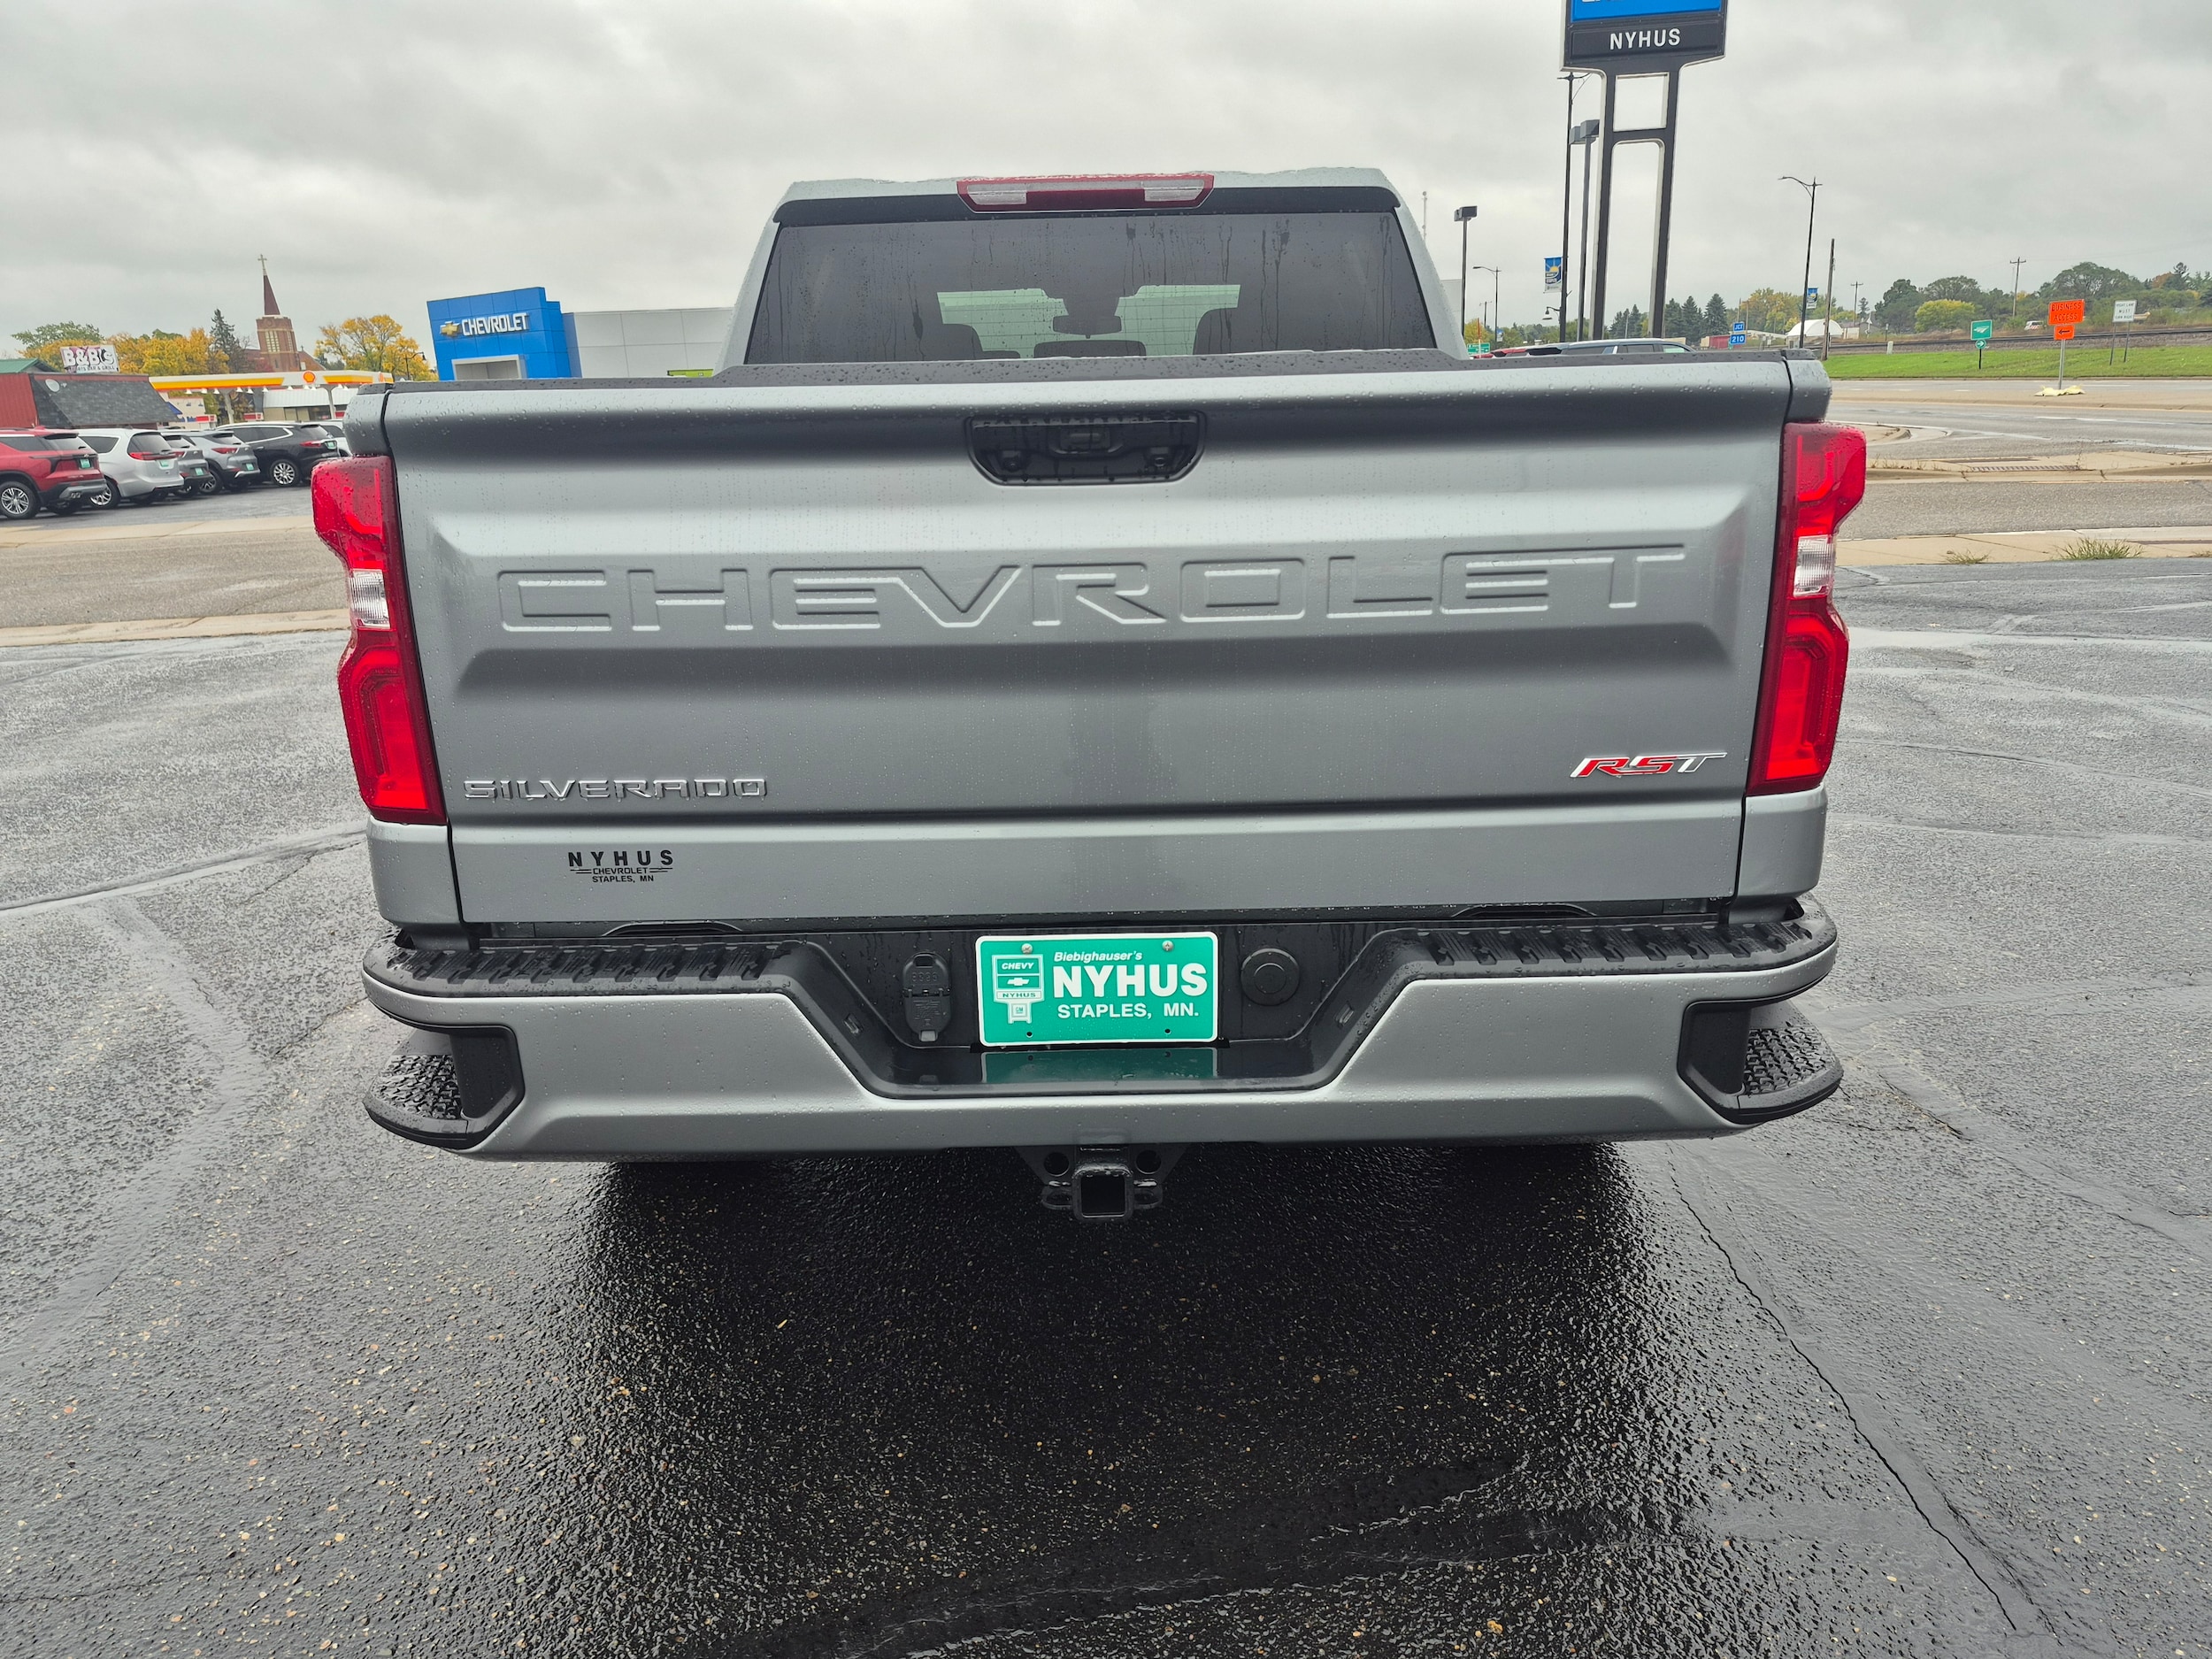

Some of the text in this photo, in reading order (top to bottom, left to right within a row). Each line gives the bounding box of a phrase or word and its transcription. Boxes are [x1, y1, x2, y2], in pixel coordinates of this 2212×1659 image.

[1609, 27, 1681, 50] NYHUS
[2051, 302, 2082, 312] BUSINESS
[2054, 312, 2078, 321] ACCESS
[461, 312, 527, 336] CHEVROLET
[496, 543, 1686, 632] CHEVROLET
[1570, 752, 1728, 779] RST
[463, 778, 768, 799] SILVERADO
[568, 849, 673, 867] NYHUS
[640, 874, 655, 883] MN
[1054, 951, 1143, 964] Biebighauser's
[1052, 963, 1209, 998] NYHUS
[1057, 1002, 1199, 1019] STAPLES, MN.
